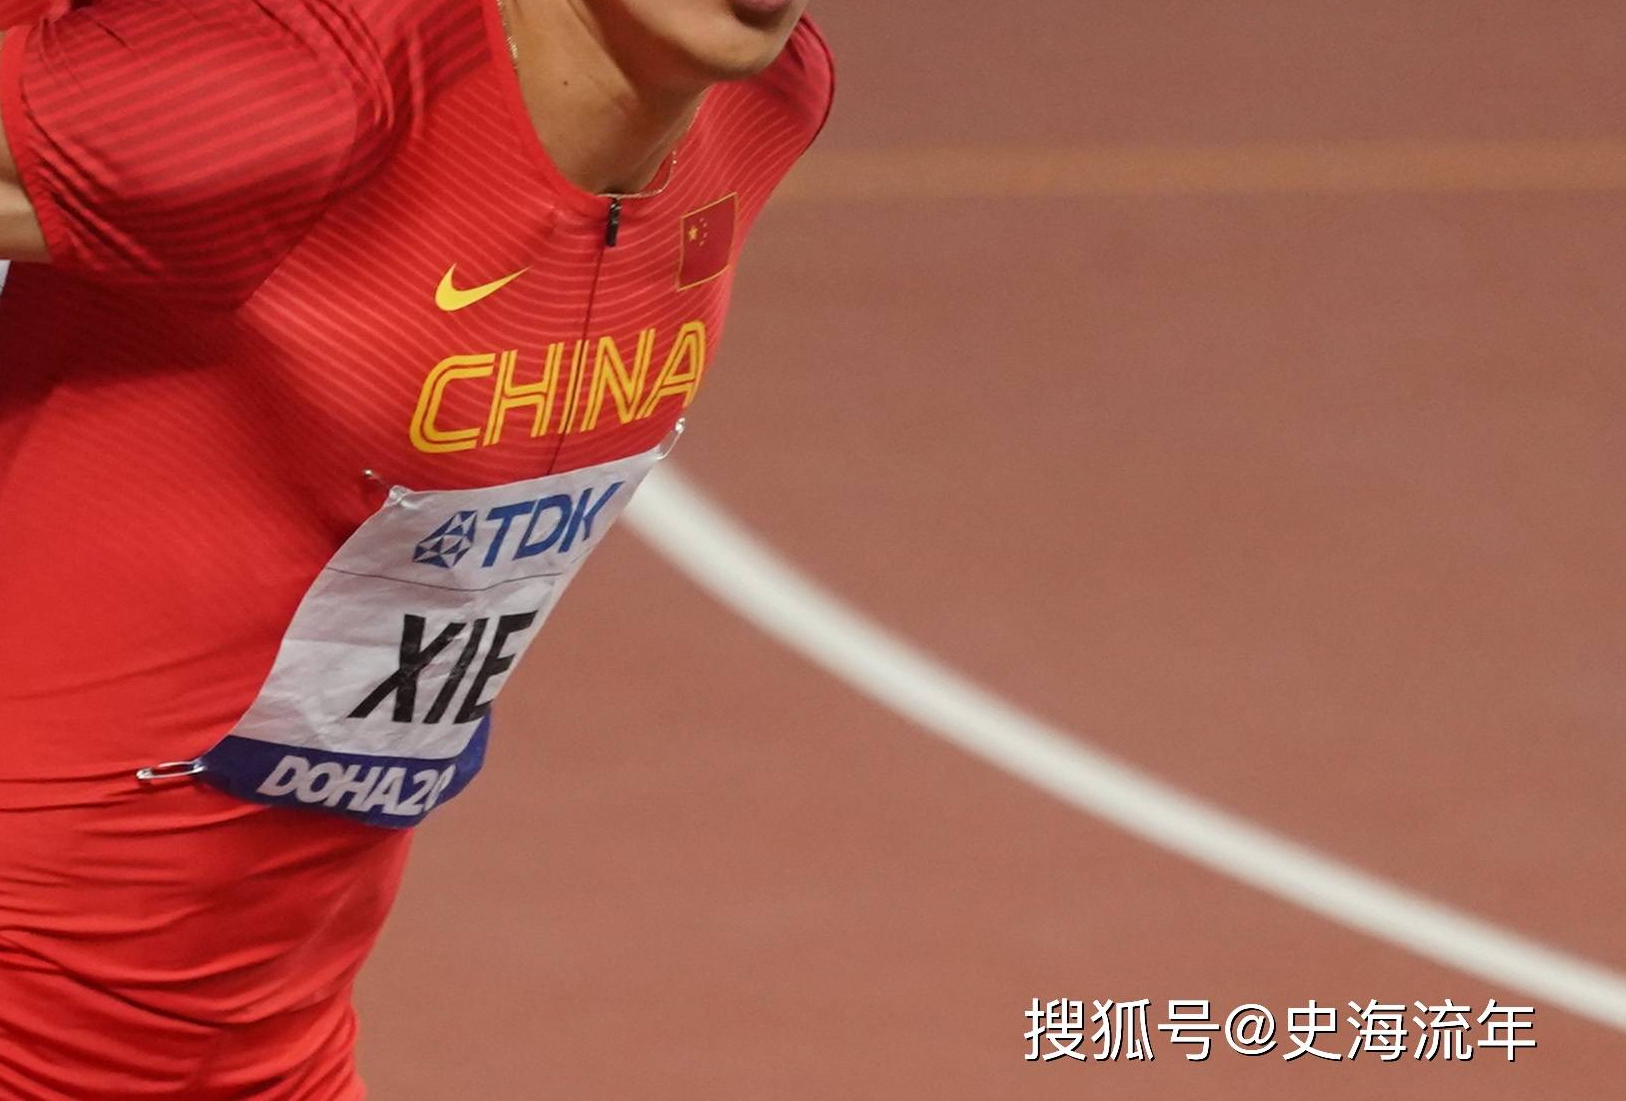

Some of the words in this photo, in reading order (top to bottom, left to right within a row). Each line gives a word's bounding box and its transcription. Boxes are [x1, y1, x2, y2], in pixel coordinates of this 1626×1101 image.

[409, 320, 707, 454] CHINA
[478, 481, 625, 568] TDK
[348, 609, 539, 725] XIE
